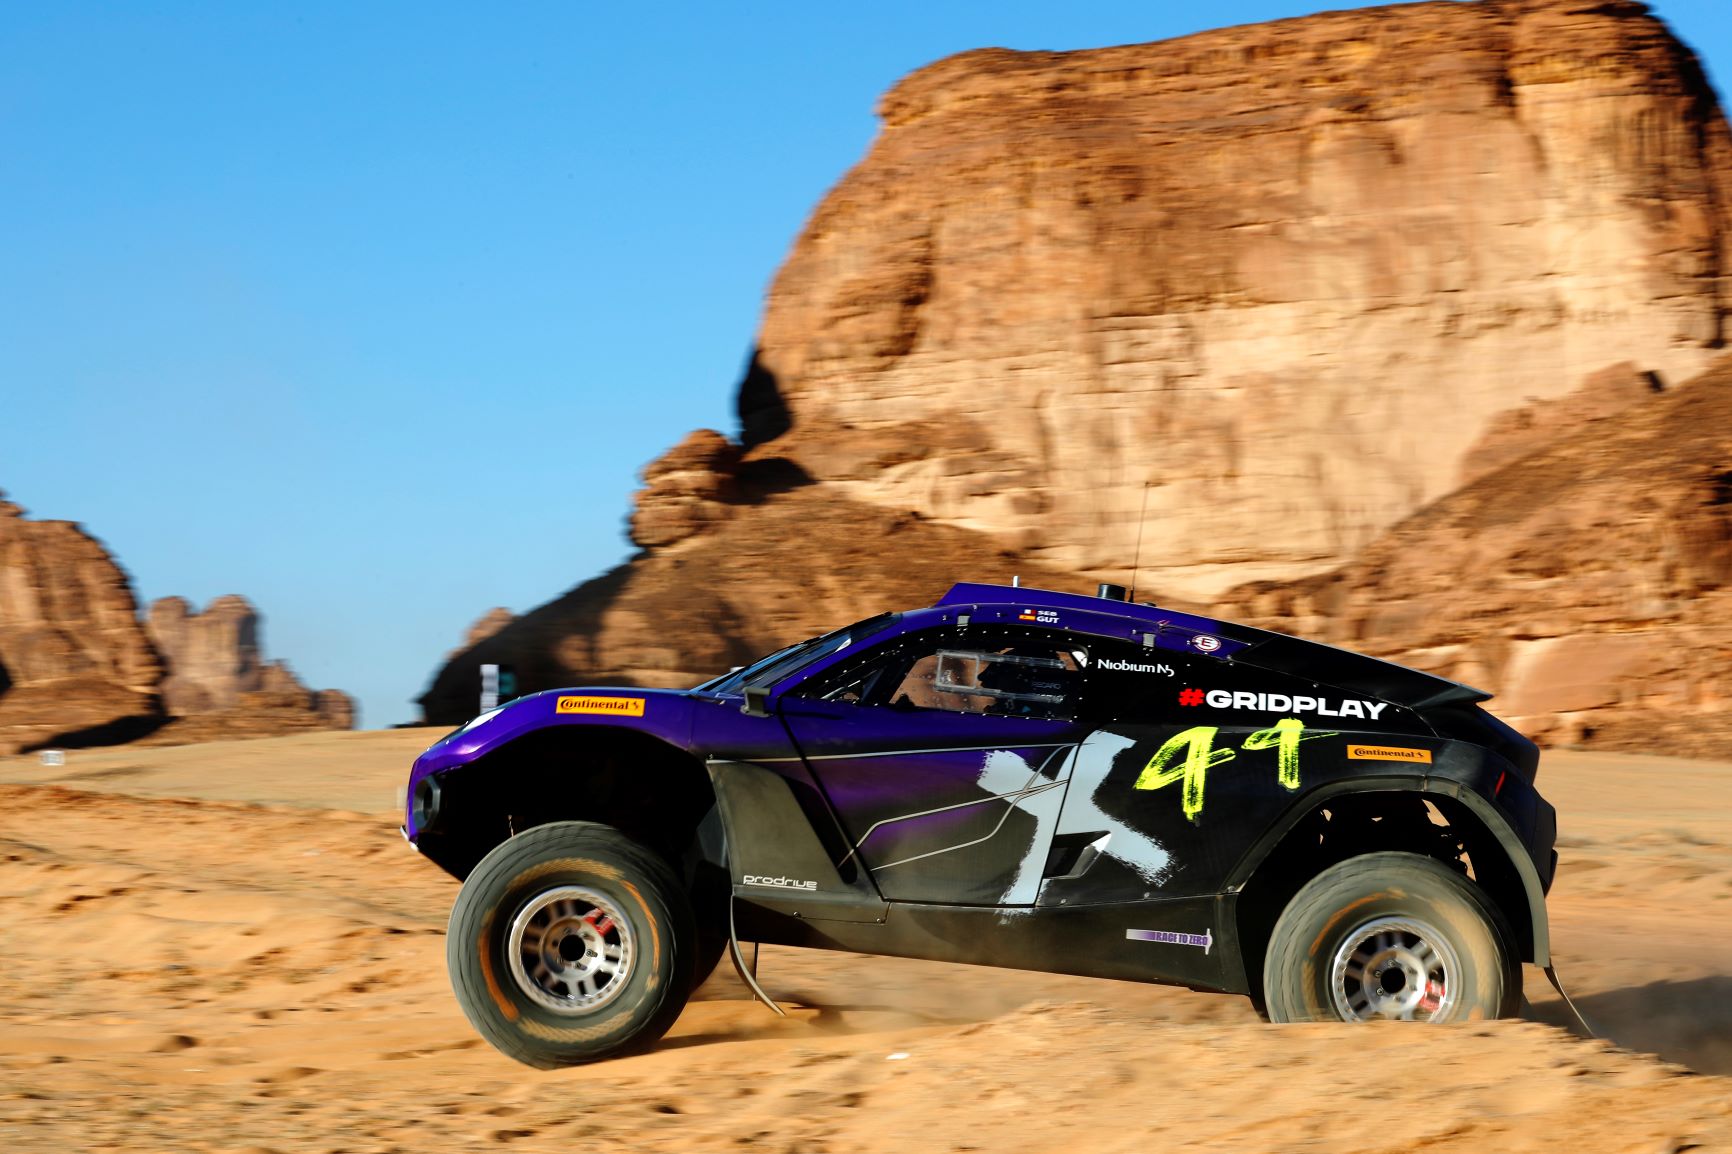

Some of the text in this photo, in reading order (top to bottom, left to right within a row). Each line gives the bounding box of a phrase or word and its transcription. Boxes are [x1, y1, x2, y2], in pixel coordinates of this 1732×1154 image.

[1036, 615, 1060, 623] GUT
[1097, 659, 1155, 673] Niobium
[560, 699, 629, 710] Continental
[1178, 688, 1388, 720] #GRIDPLAY
[1354, 748, 1415, 757] Continental
[743, 875, 818, 891] prodrive
[1156, 932, 1208, 946] RACE TO ZERO
